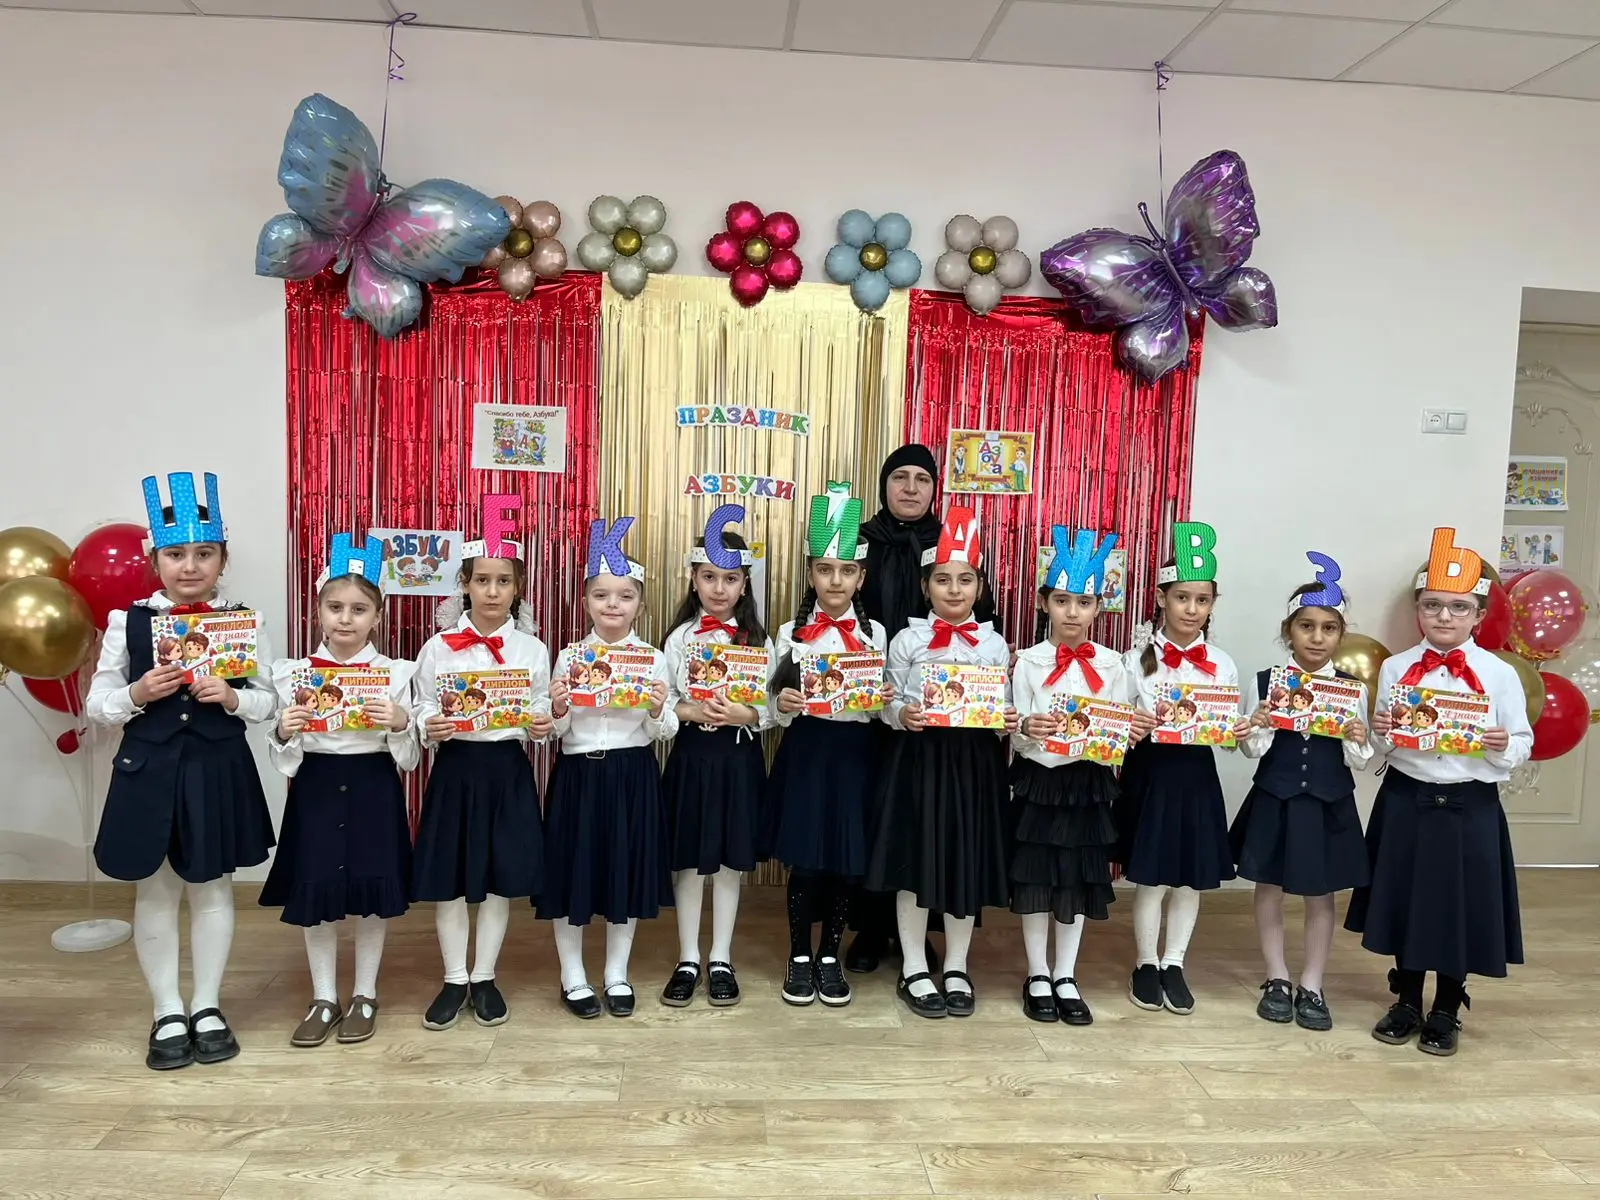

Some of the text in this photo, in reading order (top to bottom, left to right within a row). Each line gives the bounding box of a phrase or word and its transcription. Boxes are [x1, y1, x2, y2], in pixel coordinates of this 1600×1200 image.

[678, 407, 808, 433] ПРАЗДНИК
[142, 472, 224, 551] Ш
[684, 475, 794, 500] АЗБУКИ
[382, 534, 450, 561] АЗБУКА
[482, 493, 521, 560] Е
[587, 516, 635, 578] К
[704, 503, 746, 570] С
[808, 480, 862, 561] Й
[330, 532, 383, 587] Н
[1046, 524, 1119, 596] Ж
[1173, 521, 1217, 582] В
[1300, 551, 1342, 606] З
[343, 677, 386, 685] ДИПЛОМ
[844, 659, 878, 668] ДИПЛОМ
[965, 675, 1001, 683] ДИПЛОМ
